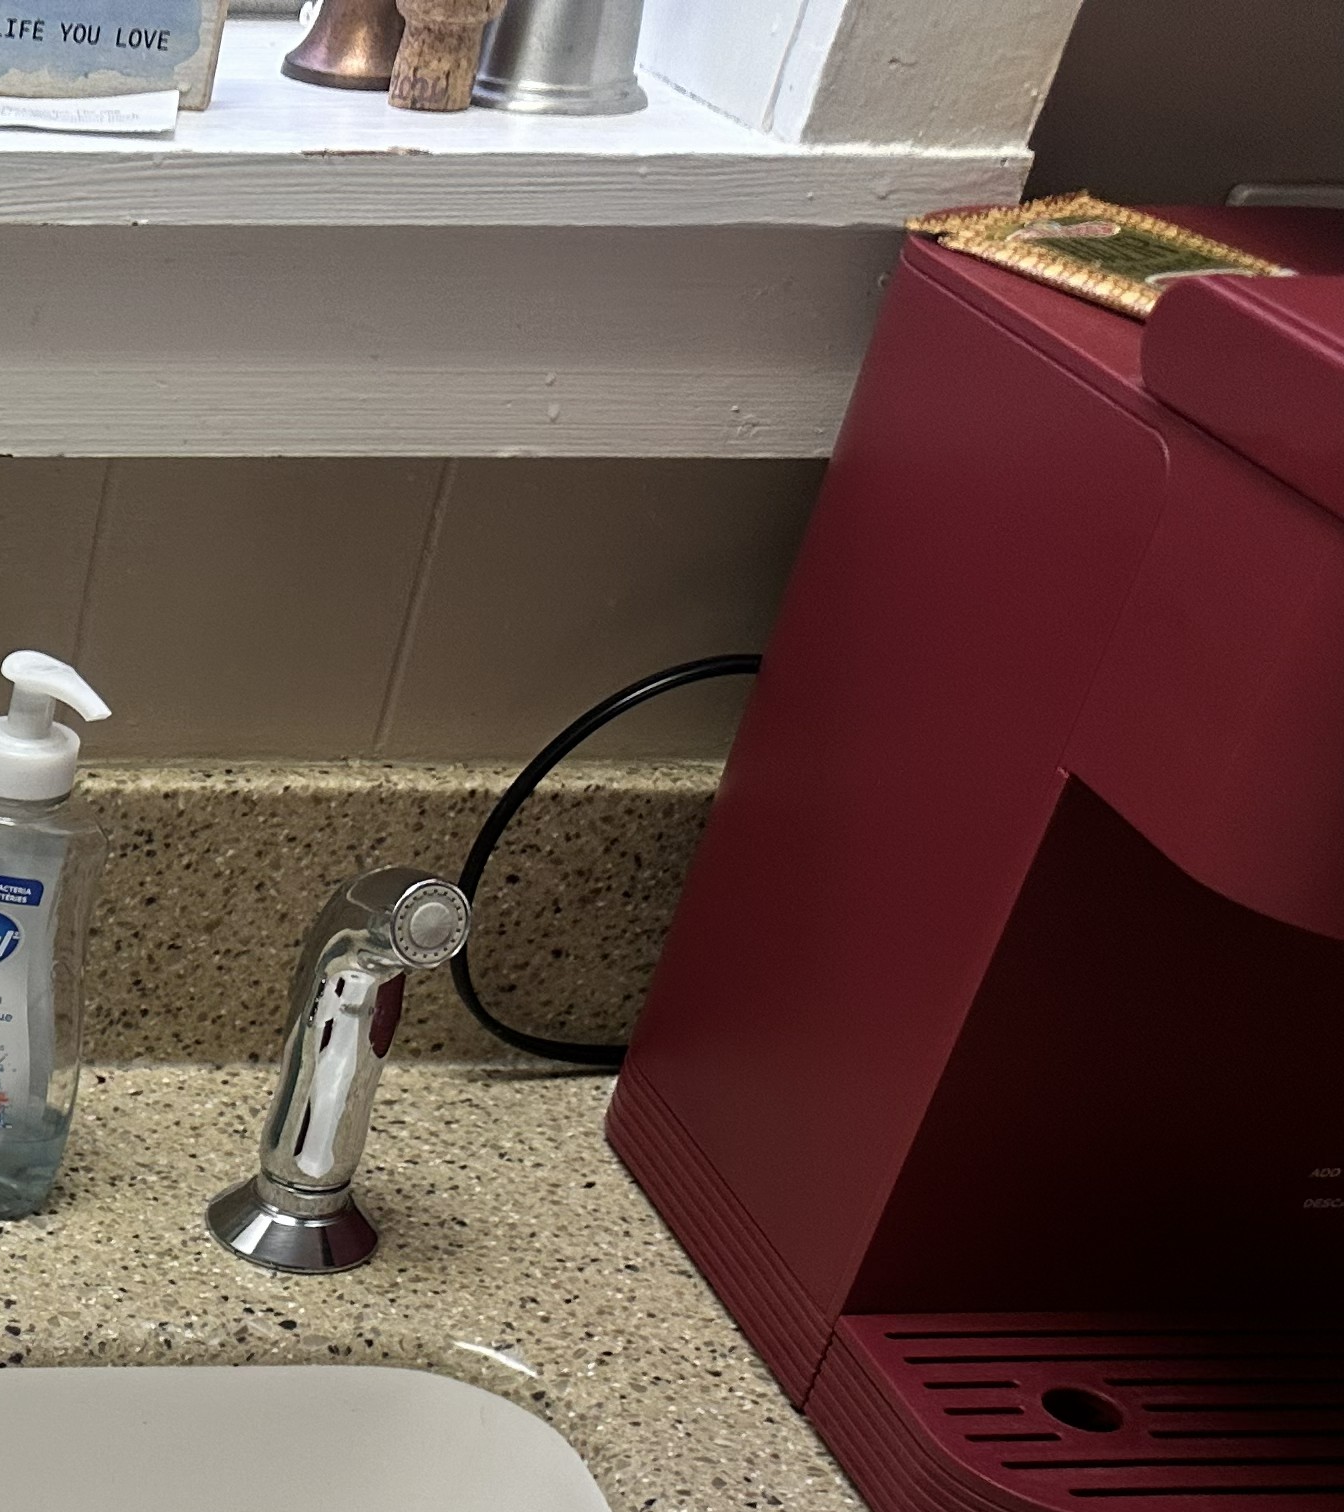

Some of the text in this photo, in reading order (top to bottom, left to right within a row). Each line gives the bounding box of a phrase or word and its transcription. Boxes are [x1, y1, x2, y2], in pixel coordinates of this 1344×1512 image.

[60, 22, 101, 46] YOU
[115, 27, 171, 51] LOVE
[1308, 1167, 1342, 1178] ADD
